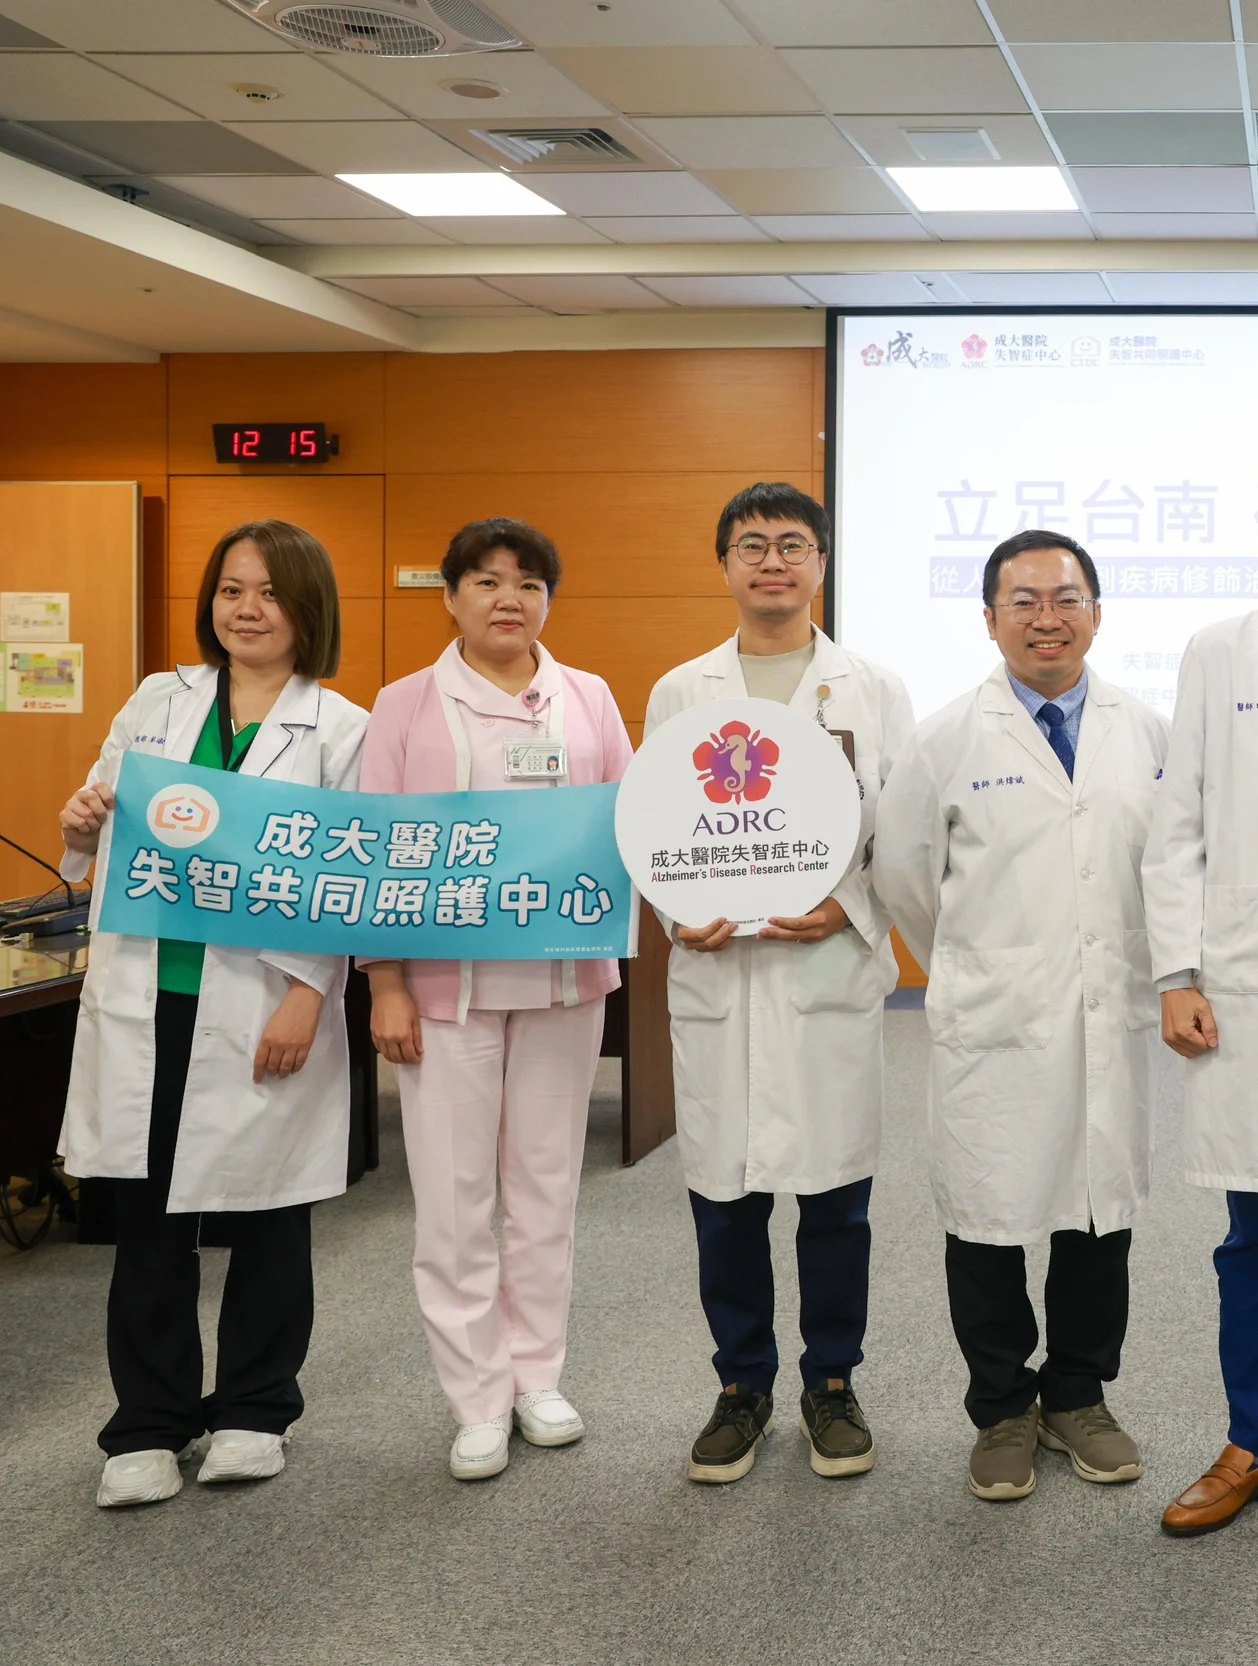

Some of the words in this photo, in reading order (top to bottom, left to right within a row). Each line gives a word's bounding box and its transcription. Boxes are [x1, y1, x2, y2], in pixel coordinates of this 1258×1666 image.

[994, 334, 1048, 347] 成大醫院
[1109, 336, 1157, 347] 成大醫院
[994, 349, 1061, 361] 失智症中心
[233, 431, 260, 456] 12
[290, 430, 317, 456] 15
[1237, 702, 1253, 711] 醫師
[692, 808, 786, 836] ADRC
[257, 811, 500, 870] 成大醫院
[651, 840, 829, 868] 成大醫院失智症中心
[709, 866, 747, 879] Disease
[750, 862, 795, 875] Research
[797, 860, 829, 873] Center
[127, 847, 613, 927] 失智共同照護中心
